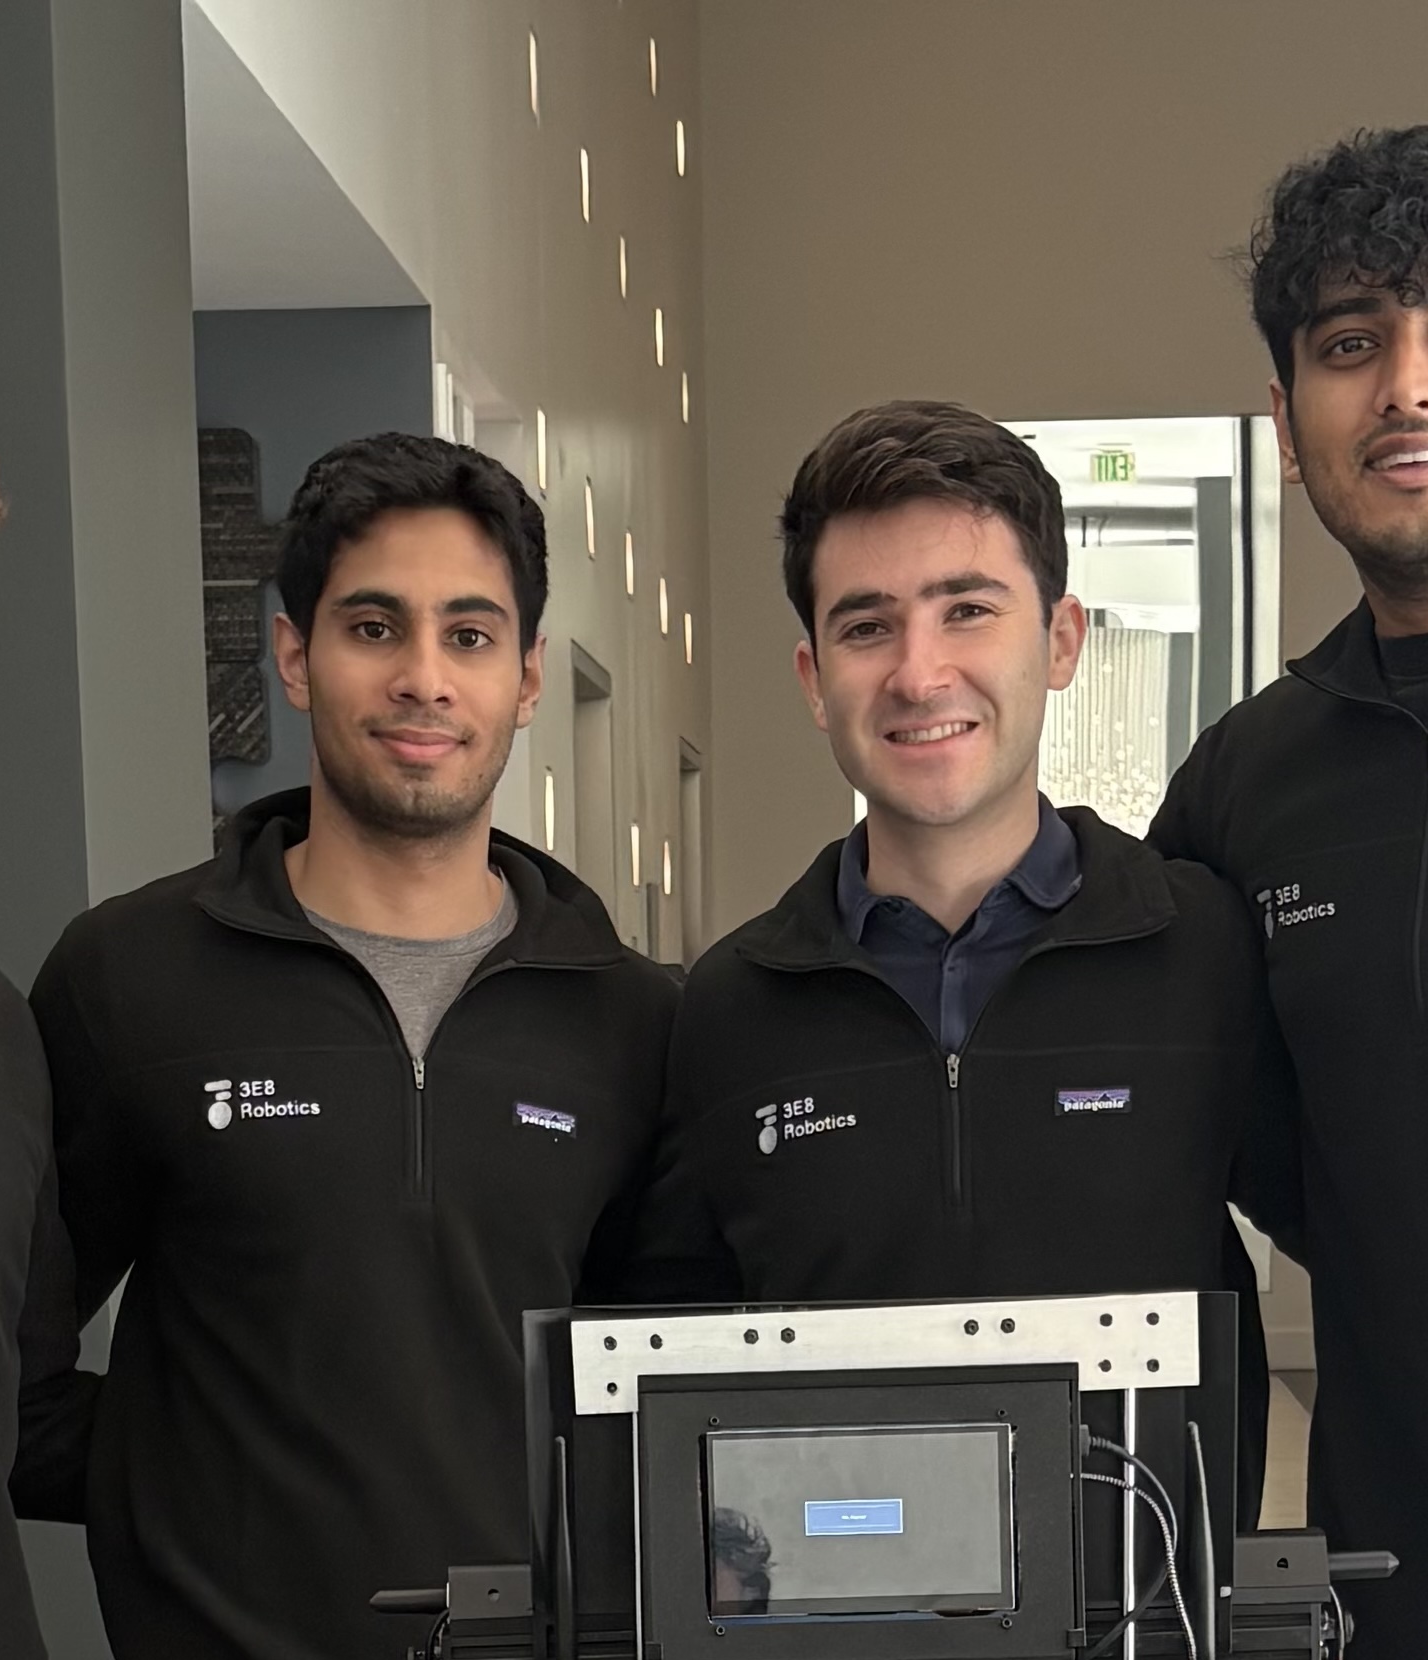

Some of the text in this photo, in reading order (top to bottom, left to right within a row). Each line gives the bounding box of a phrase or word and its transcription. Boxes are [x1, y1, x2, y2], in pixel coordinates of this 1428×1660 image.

[1275, 883, 1300, 905] 3E8
[239, 1079, 275, 1098] 3E8
[240, 1099, 321, 1120] Robotics
[783, 1096, 815, 1119] 3E8
[784, 1114, 857, 1140] Robotics
